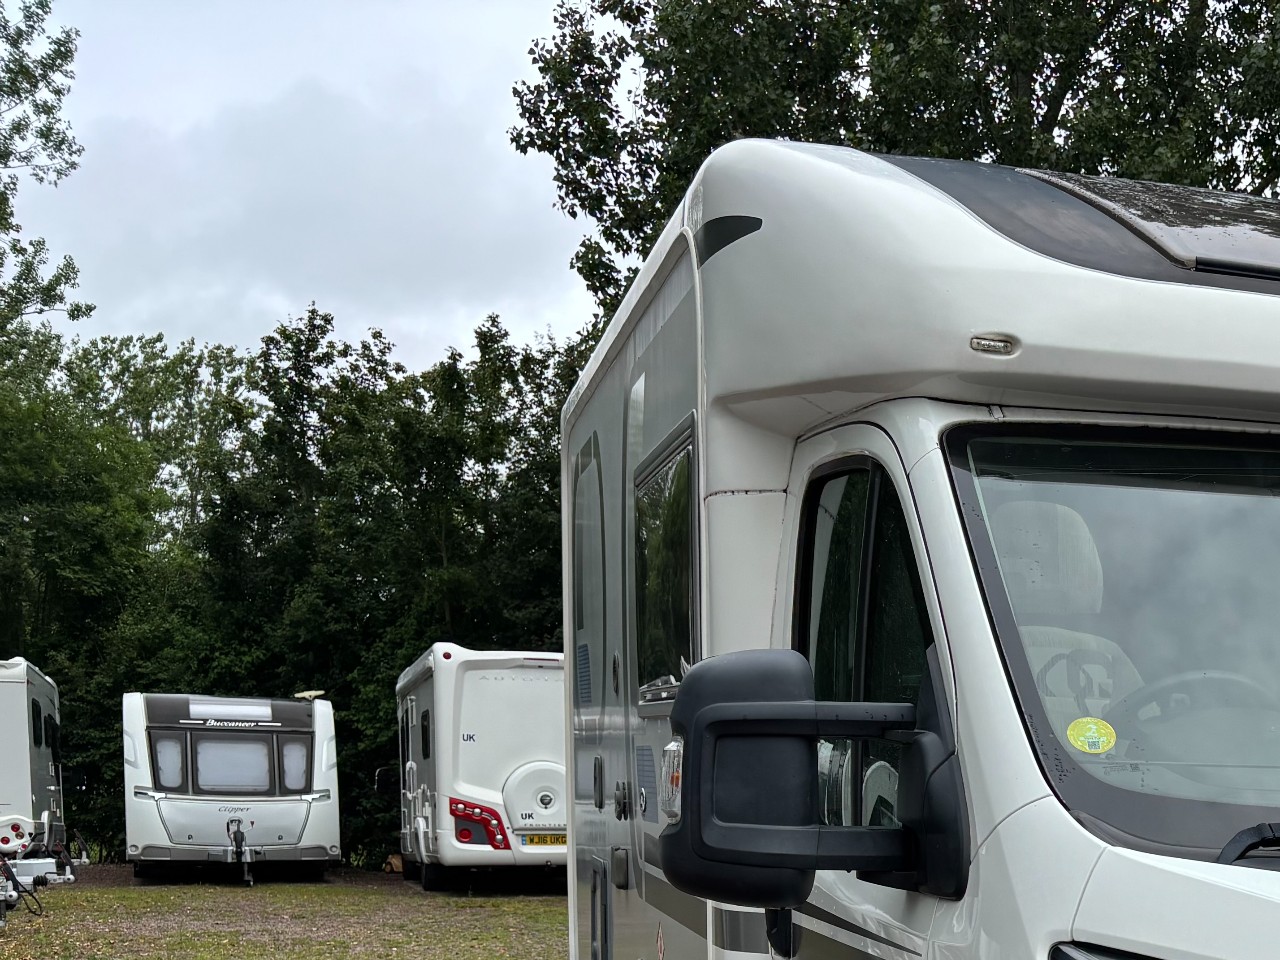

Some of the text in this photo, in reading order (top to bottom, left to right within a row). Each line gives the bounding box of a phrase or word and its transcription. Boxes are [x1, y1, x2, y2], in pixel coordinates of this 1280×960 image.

[206, 719, 257, 728] Buccaneer
[462, 733, 476, 742] UK
[218, 805, 252, 814] Clipper
[520, 812, 535, 820] UK
